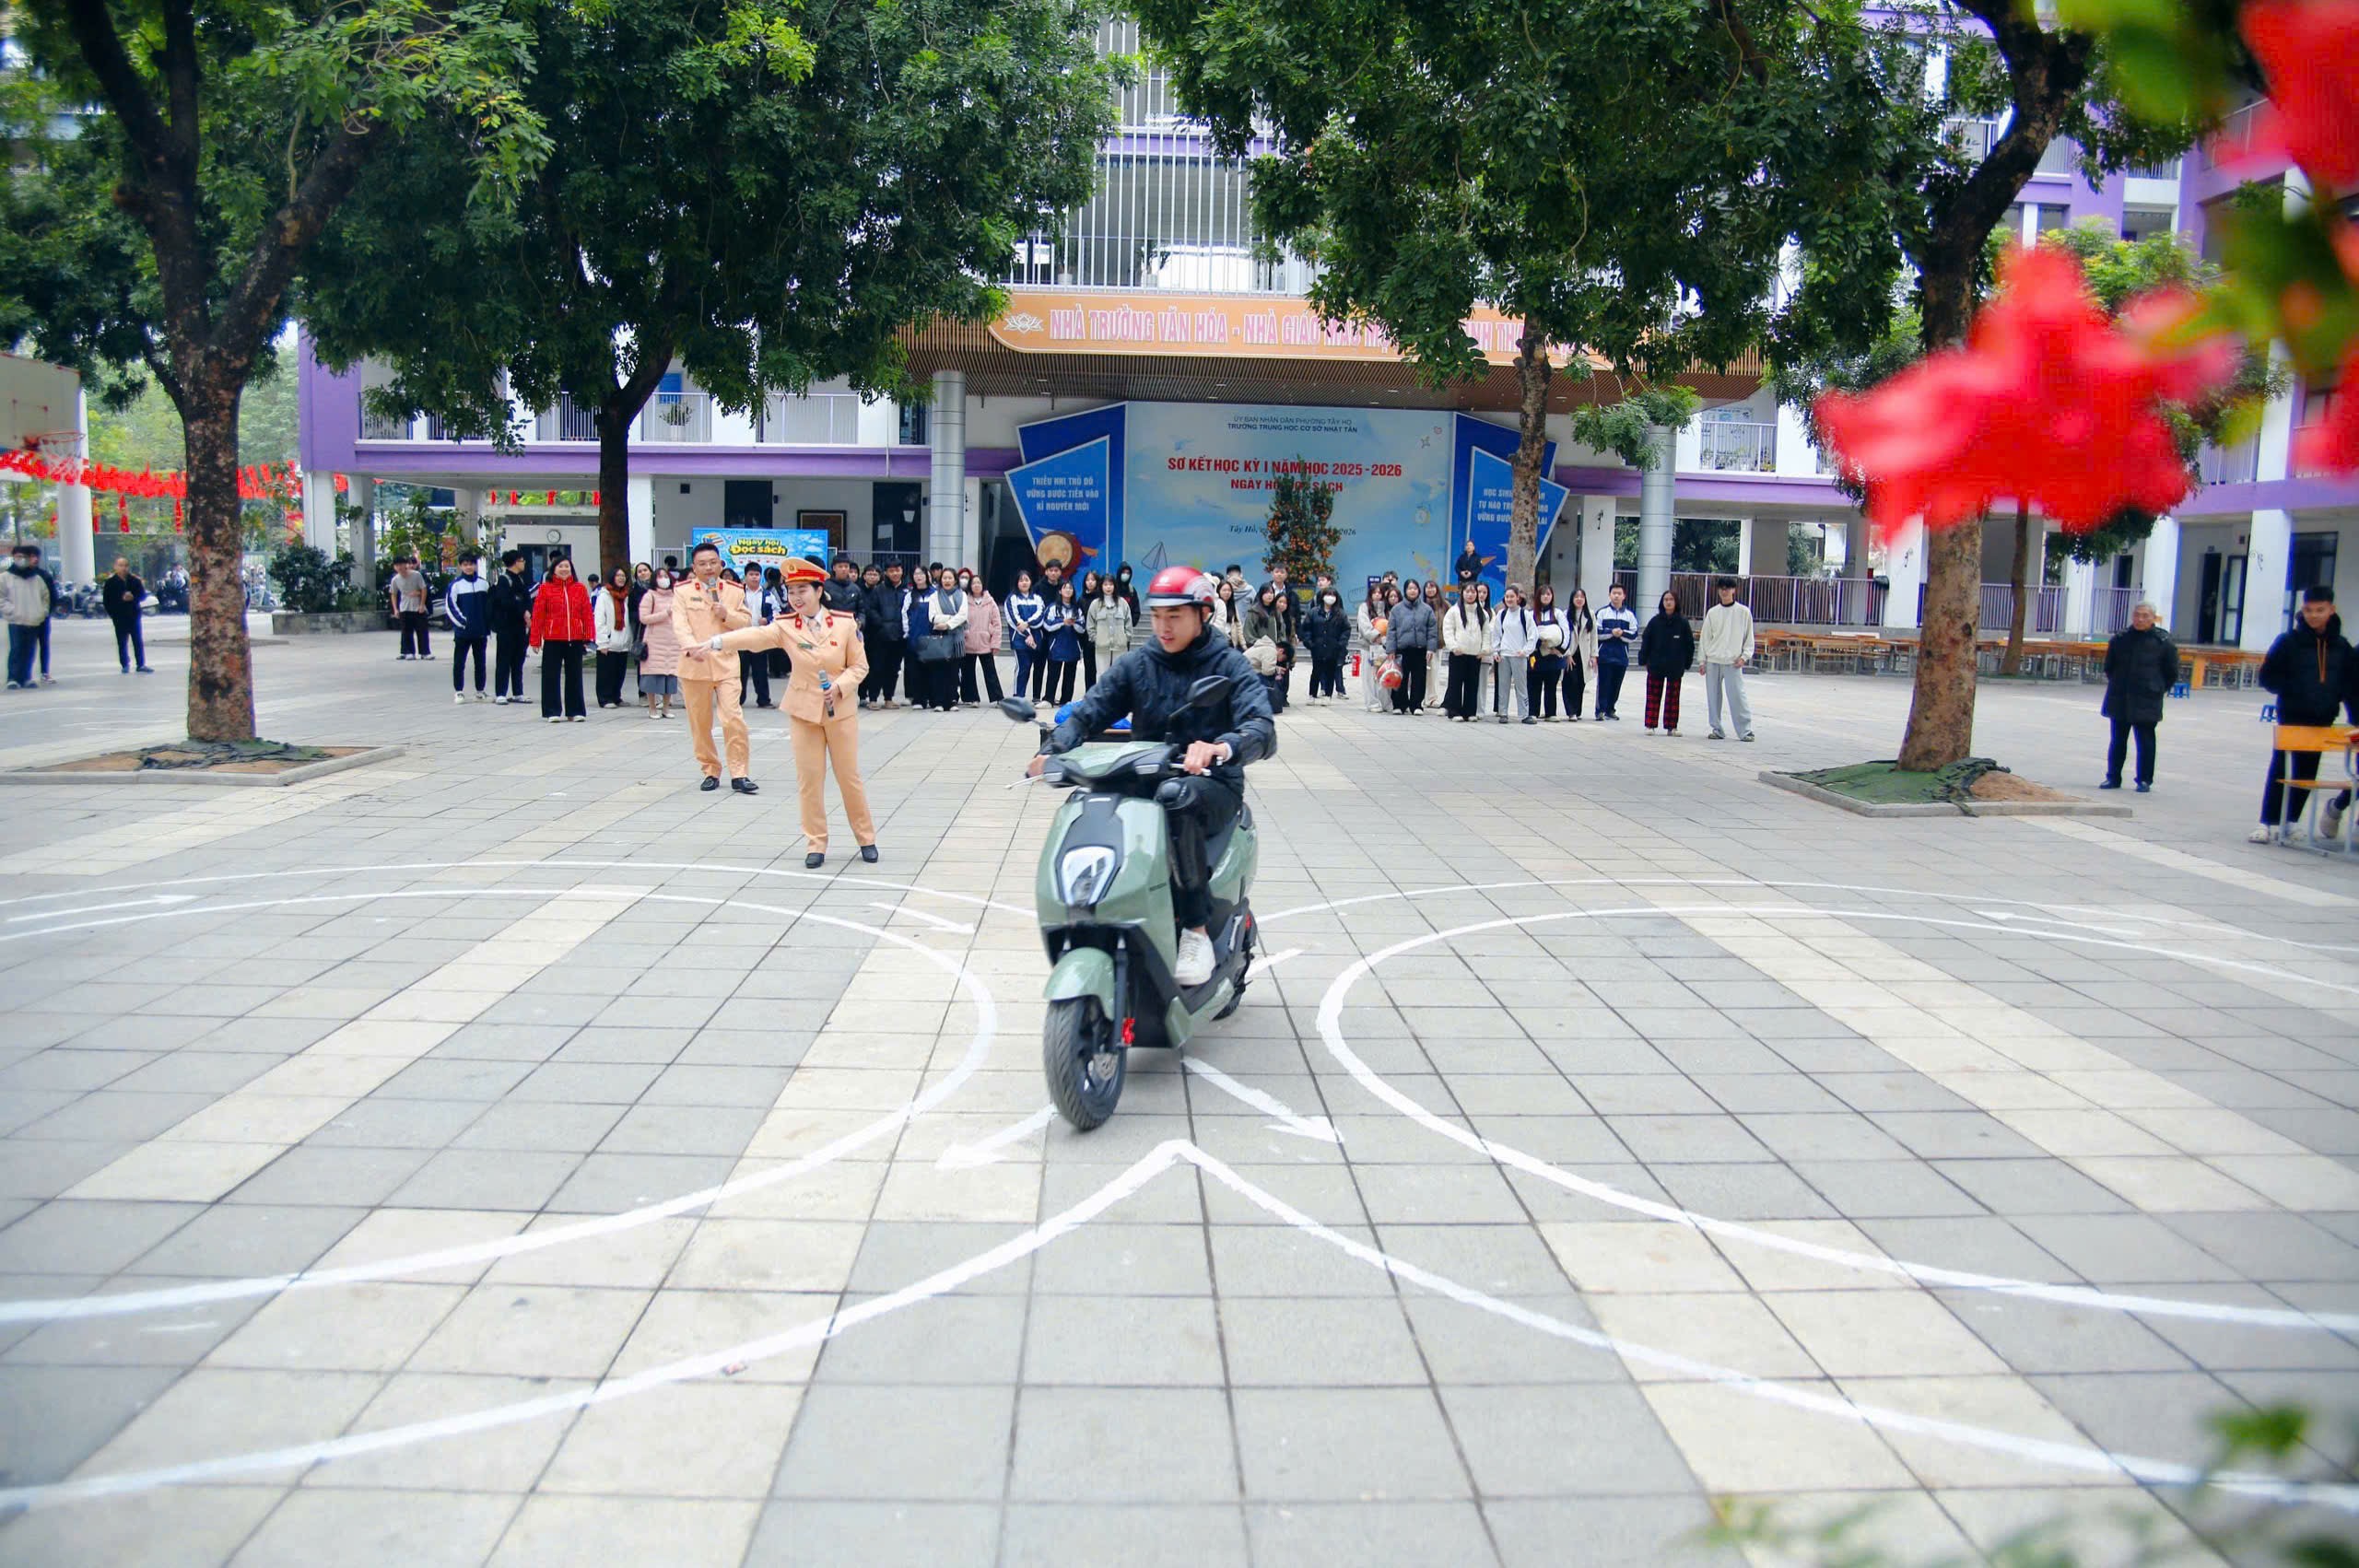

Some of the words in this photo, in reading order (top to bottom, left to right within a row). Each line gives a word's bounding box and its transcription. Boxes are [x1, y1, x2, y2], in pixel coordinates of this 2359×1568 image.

[1050, 303, 1086, 340] NHÀ
[1088, 303, 1155, 341] TRƯỜNG
[1157, 305, 1191, 342] VĂN
[1194, 307, 1228, 343] HÓA
[1243, 308, 1279, 345] NHÀ
[1282, 310, 1320, 345] GIÁO
[1168, 458, 1185, 471] SƠ
[1189, 455, 1212, 472] KẾT
[1214, 460, 1239, 474] HỌC
[1244, 458, 1261, 473] KỲ
[1264, 461, 1269, 473] I
[1272, 458, 1301, 474] NĂM
[1305, 462, 1329, 477] HỌC
[1231, 477, 1262, 490] NGÀY
[1312, 481, 1344, 492] SCH
